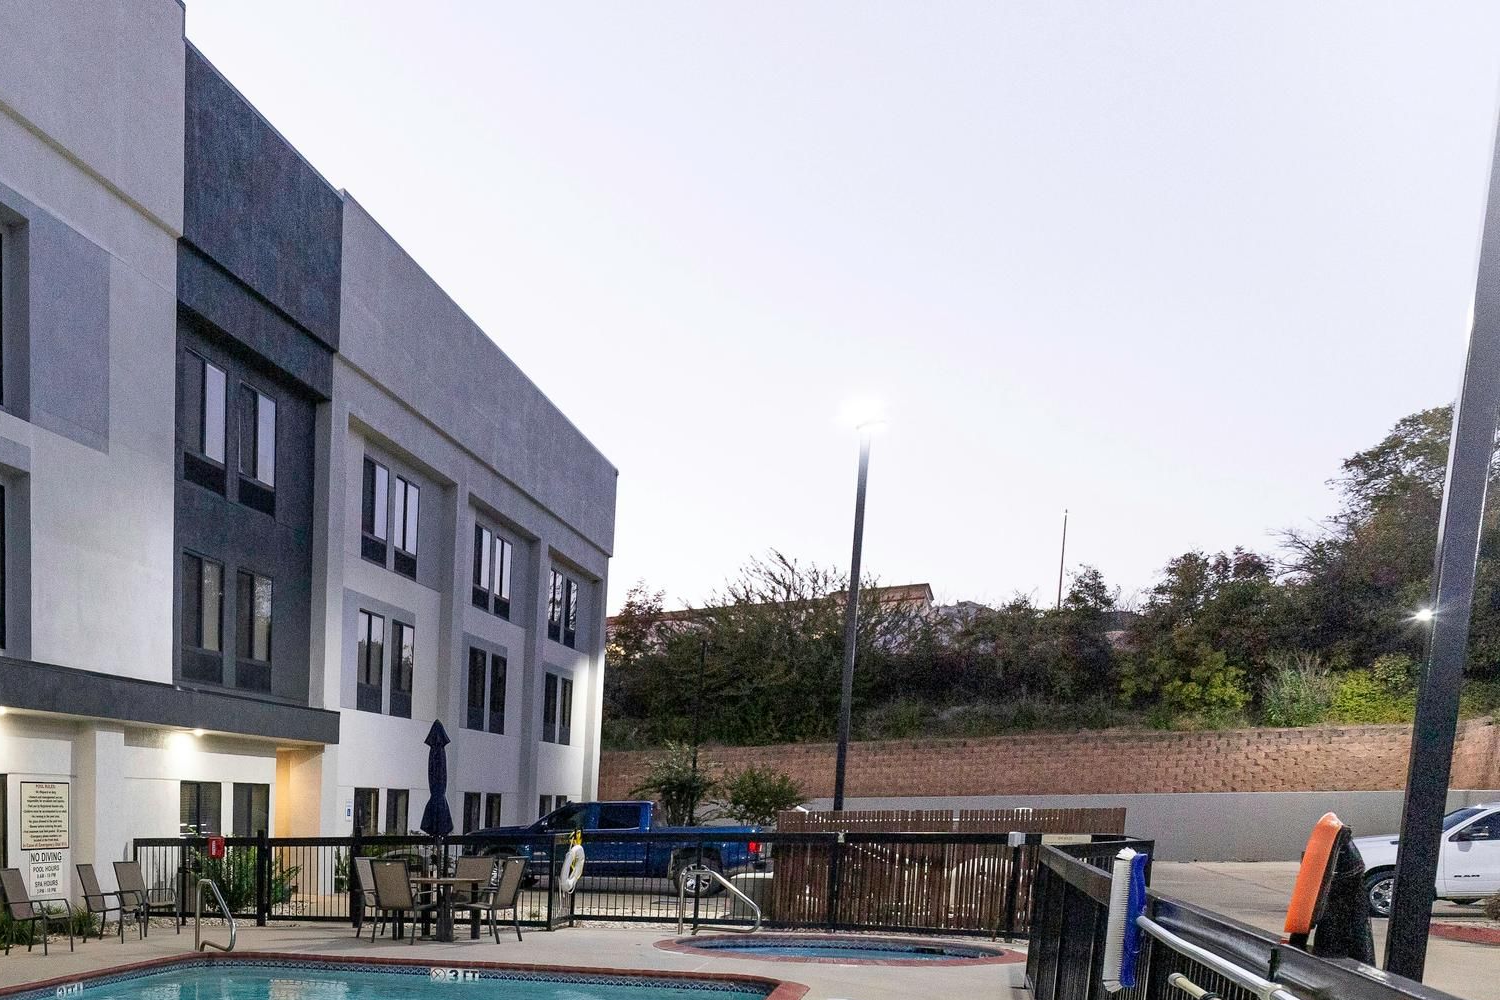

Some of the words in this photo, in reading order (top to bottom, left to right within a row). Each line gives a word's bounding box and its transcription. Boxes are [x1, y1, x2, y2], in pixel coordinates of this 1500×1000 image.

[30, 852, 40, 862] NO
[41, 852, 62, 862] DIVING
[449, 970, 459, 982] 3
[463, 970, 478, 982] FT
